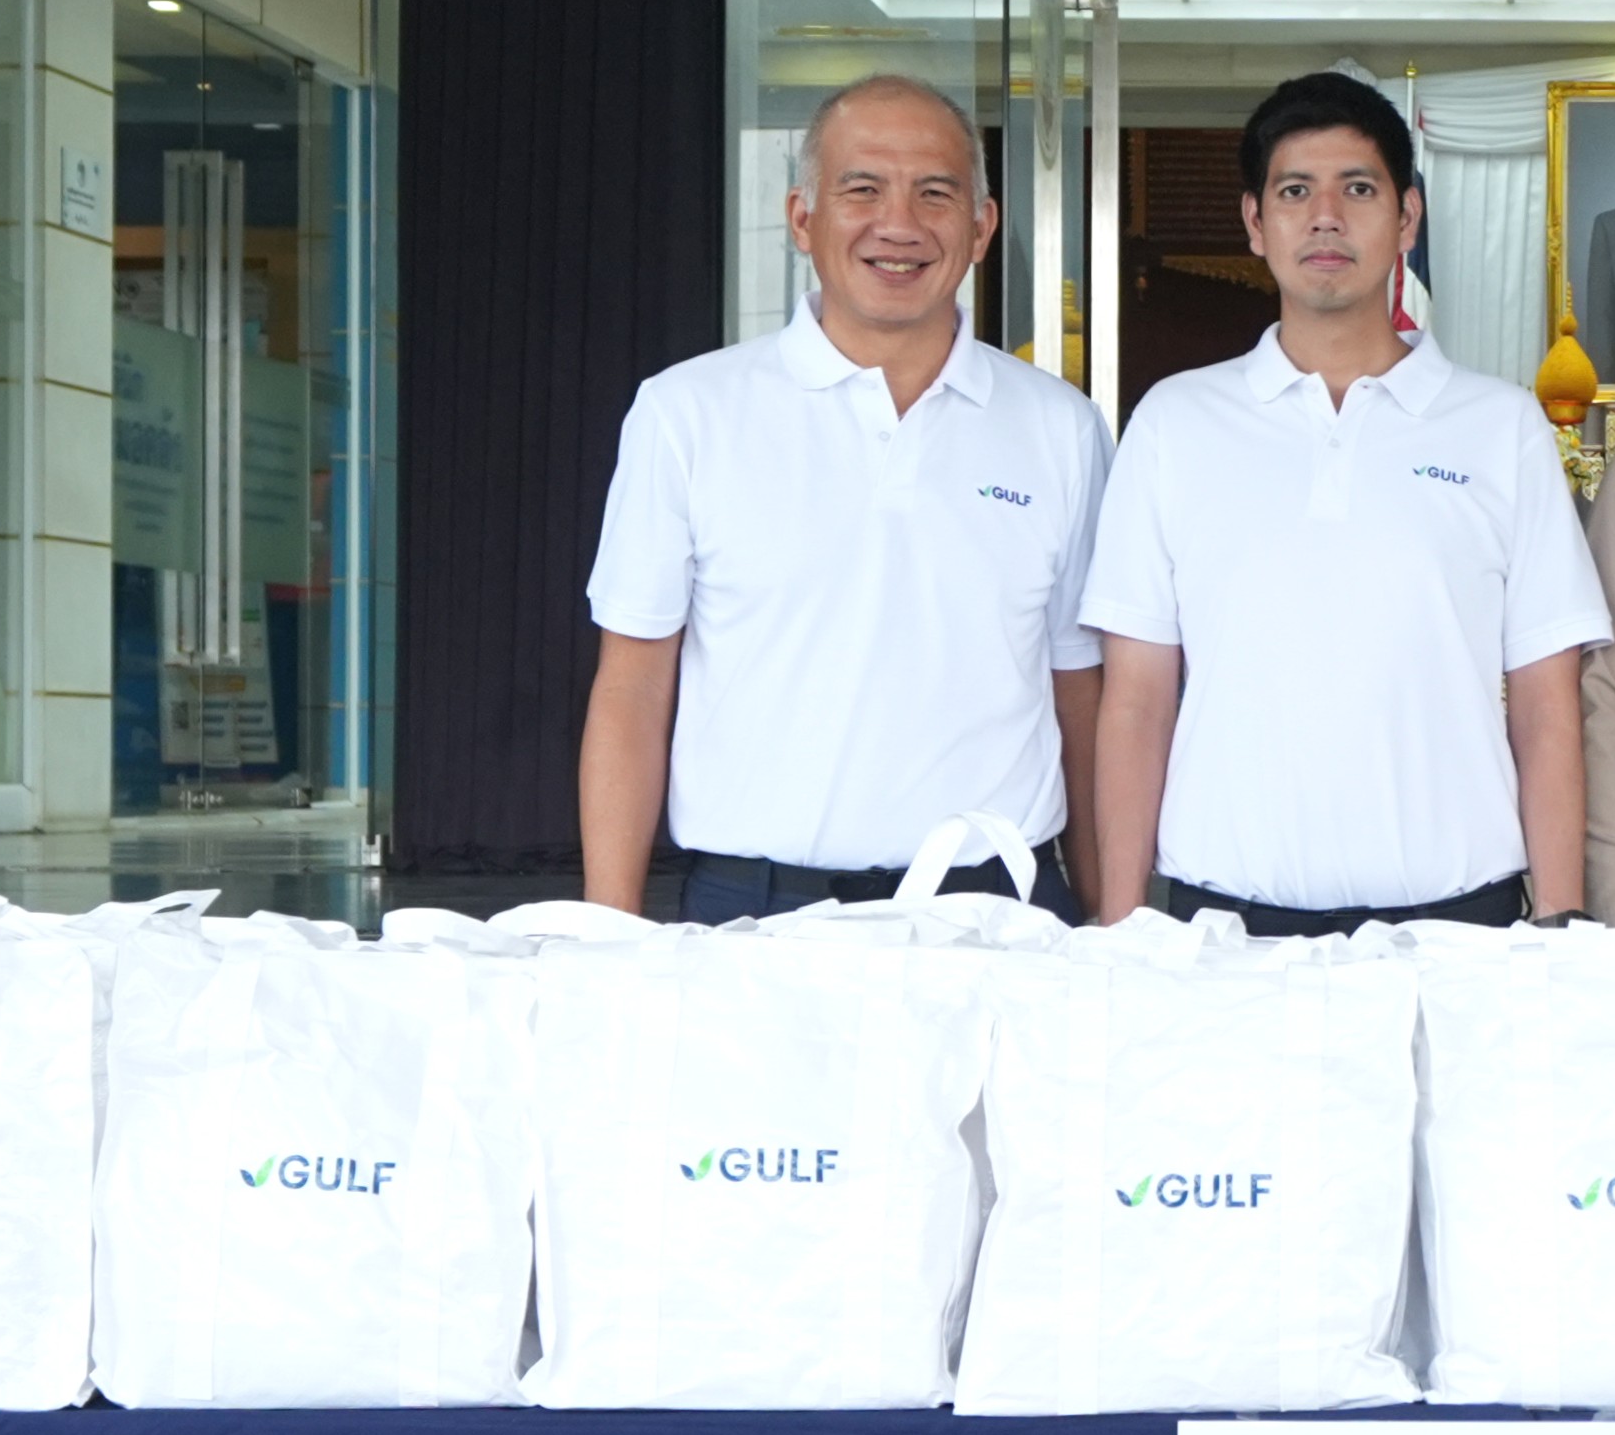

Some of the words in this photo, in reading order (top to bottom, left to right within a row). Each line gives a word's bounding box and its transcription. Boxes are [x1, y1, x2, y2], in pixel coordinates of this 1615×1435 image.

[1427, 466, 1471, 485] GULF
[991, 485, 1032, 507] GULF
[278, 1155, 397, 1195] GULF
[716, 1148, 839, 1183] GULF
[1155, 1174, 1272, 1208] GULF
